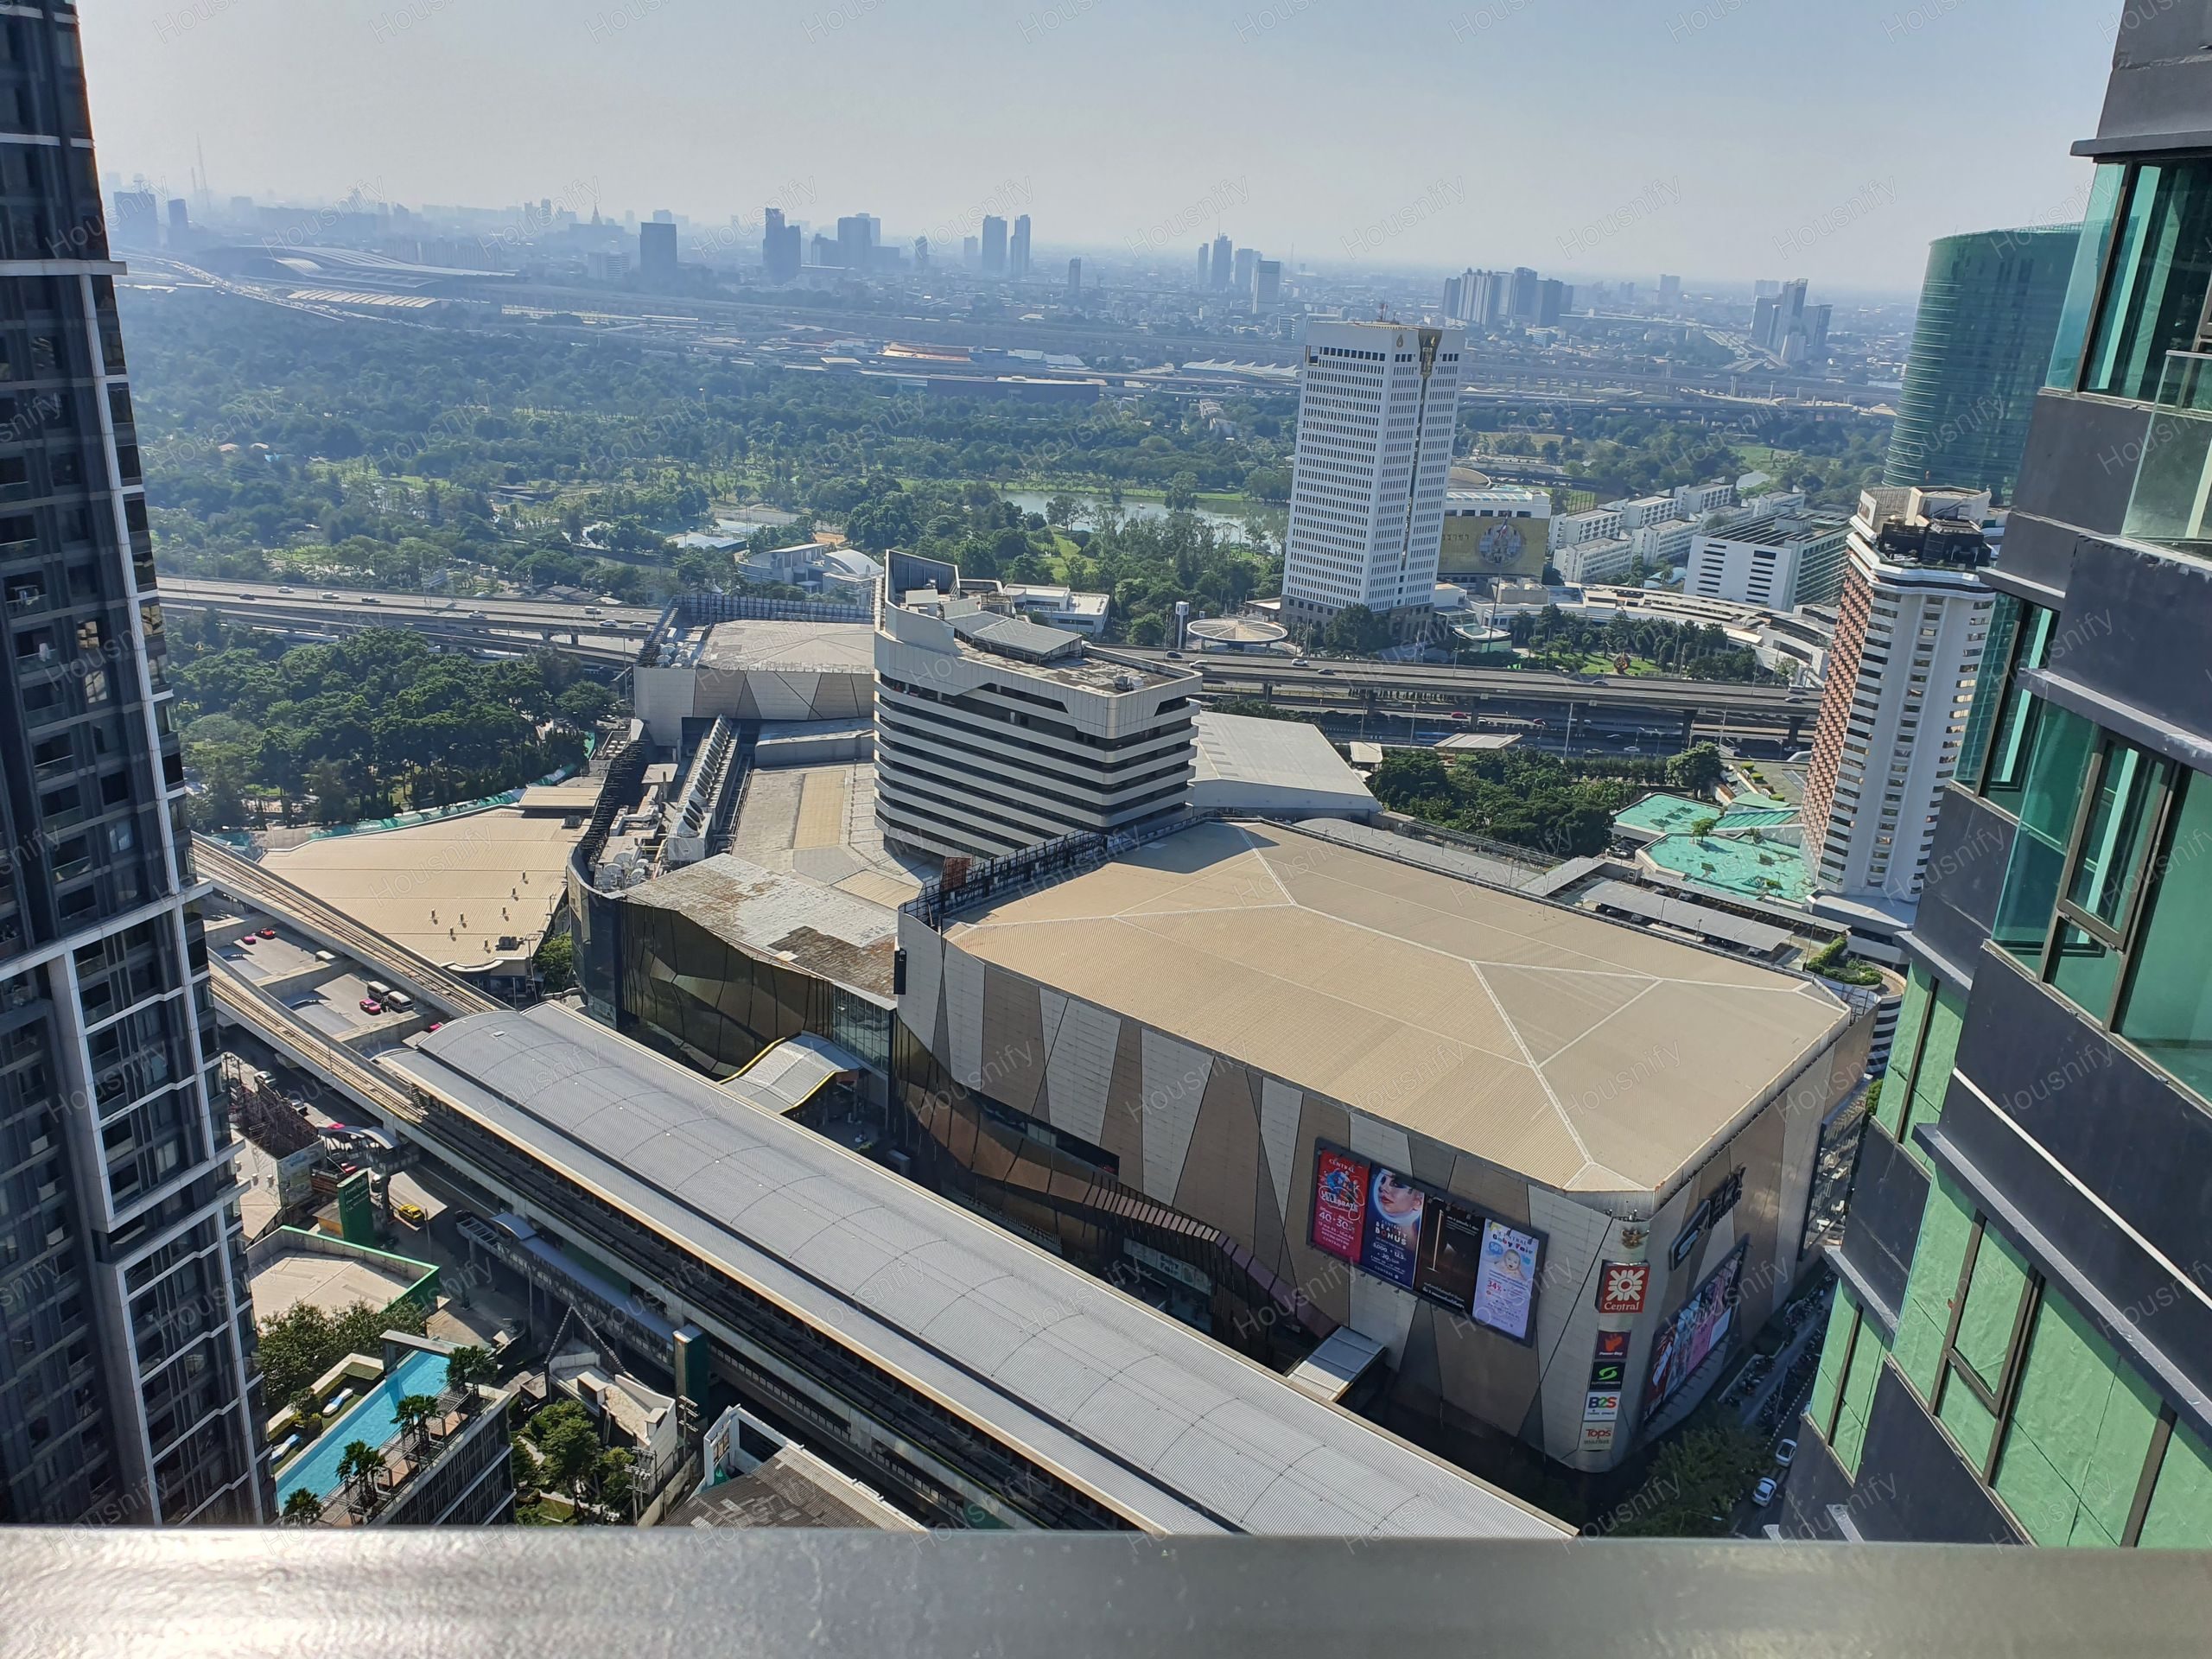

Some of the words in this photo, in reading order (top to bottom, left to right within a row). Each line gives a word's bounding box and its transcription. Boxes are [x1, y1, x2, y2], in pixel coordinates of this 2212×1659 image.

[1376, 1227, 1407, 1245] BONUS
[1604, 1301, 1640, 1312] Central
[1588, 1396, 1618, 1409] B2S
[1586, 1428, 1611, 1440] Tops
